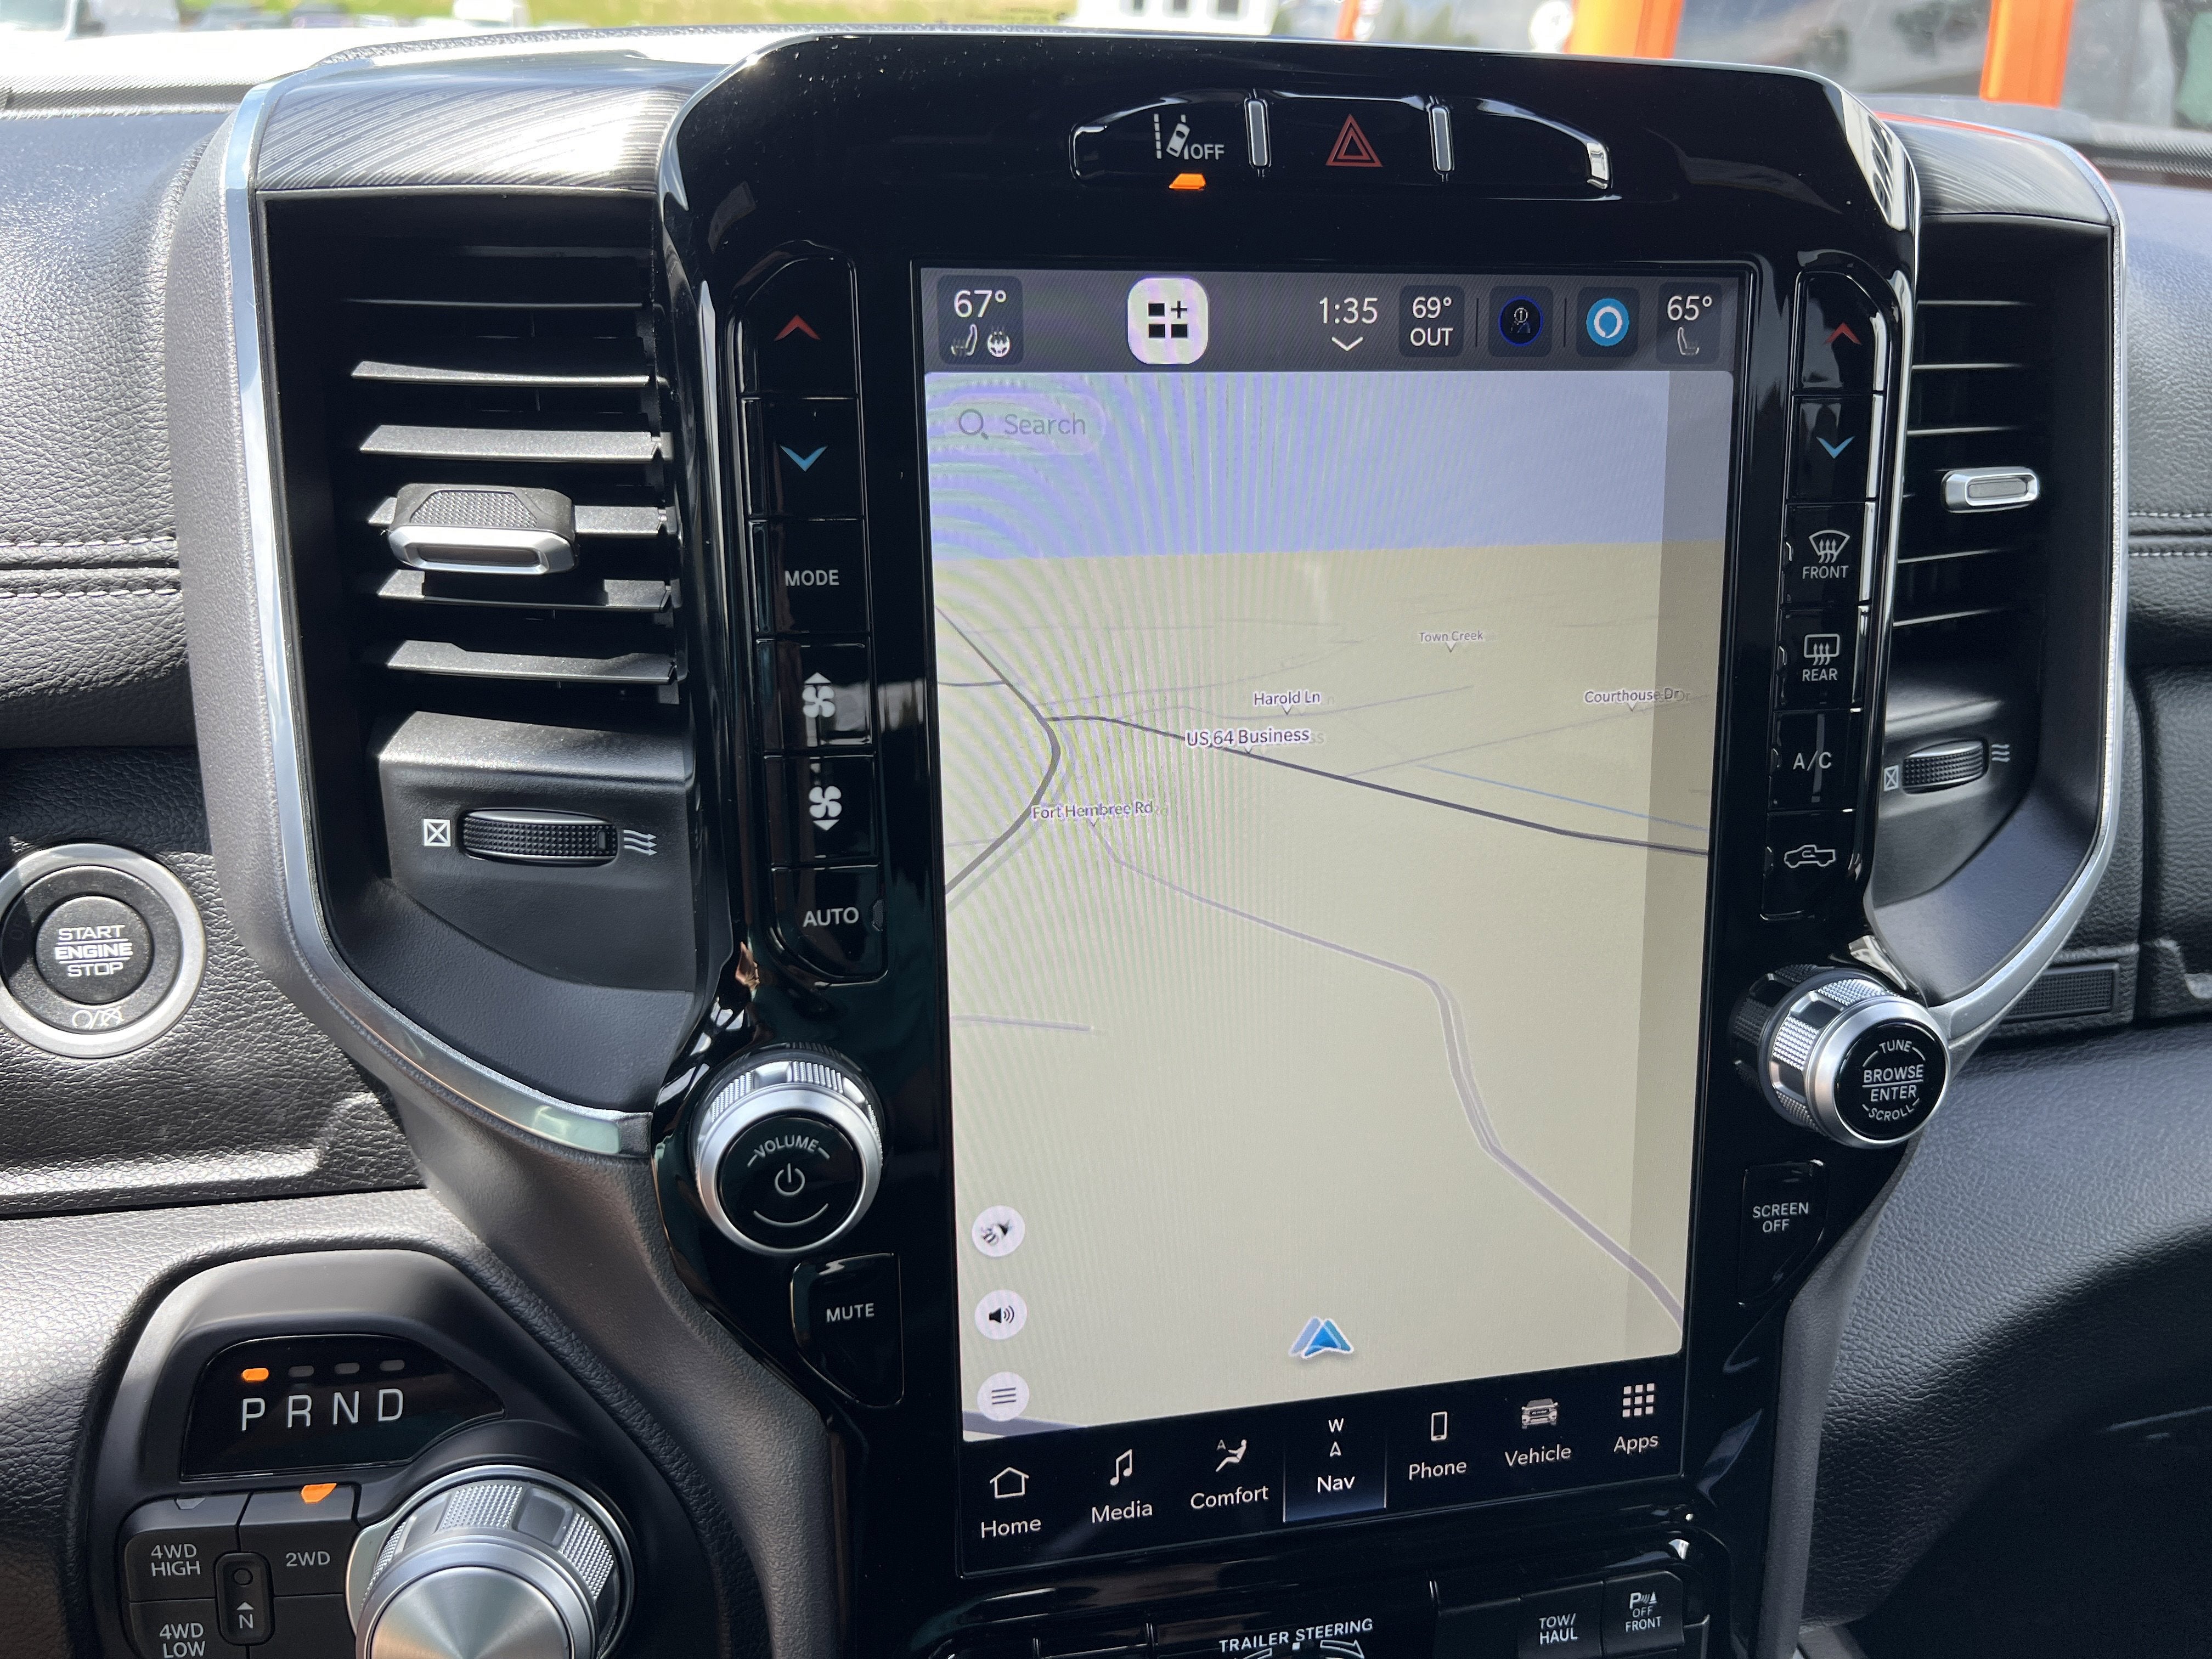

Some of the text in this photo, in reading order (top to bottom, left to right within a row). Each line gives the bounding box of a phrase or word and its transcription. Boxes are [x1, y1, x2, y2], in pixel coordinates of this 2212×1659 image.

[1191, 144, 1224, 160] OFF
[953, 290, 1007, 318] 67°
[1319, 297, 1378, 324] 1:35
[1412, 296, 1452, 319] 69°
[1666, 296, 1712, 321] 65°
[1410, 328, 1453, 347] OUT
[1004, 413, 1086, 436] Search
[785, 569, 839, 588] MODE
[1802, 566, 1849, 579] FRONT
[1419, 630, 1483, 642] Town Creek
[1802, 668, 1837, 681] REAR
[1254, 691, 1320, 706] Harold Ln
[1585, 688, 1679, 703] Courthouse Dr
[1187, 728, 1310, 746] US 64 Business
[1793, 751, 1832, 771] A/C
[1032, 800, 1153, 819] Fort Hembree Rd
[803, 907, 859, 927] AUTO
[59, 924, 125, 941] START
[55, 942, 133, 960] ENGINE
[68, 962, 123, 977] STOP
[1879, 1040, 1912, 1053] TUNE
[1864, 1064, 1923, 1084] BROWSE
[1871, 1085, 1917, 1102] ENTER
[1869, 1104, 1914, 1121] SCROLL
[754, 1135, 819, 1158] VOLUME
[1753, 1203, 1809, 1218] SCREEN
[1763, 1220, 1790, 1233] OFF
[826, 1302, 874, 1322] MUTE
[241, 1388, 403, 1431] P R N D
[1329, 1418, 1344, 1432] W
[1613, 1434, 1659, 1455] Apps
[1505, 1444, 1572, 1468] Vehicle
[1409, 1459, 1467, 1480] Phone
[1317, 1475, 1355, 1493] Nav
[1190, 1486, 1268, 1510] Comfort
[1092, 1500, 1153, 1523] Media
[981, 1519, 1042, 1539] Home
[151, 1543, 197, 1559] 4WD
[286, 1551, 330, 1567] 2WD
[151, 1560, 201, 1577] HIGH
[1539, 1613, 1576, 1627] TOW/
[1632, 1606, 1653, 1617] OFF
[160, 1622, 204, 1639] 4WD
[239, 1614, 253, 1629] N
[1626, 1617, 1662, 1632] FRONT
[1219, 1617, 1373, 1653] TRAILER STEERING
[1539, 1627, 1578, 1645] HAUL
[163, 1641, 206, 1658] LOW
